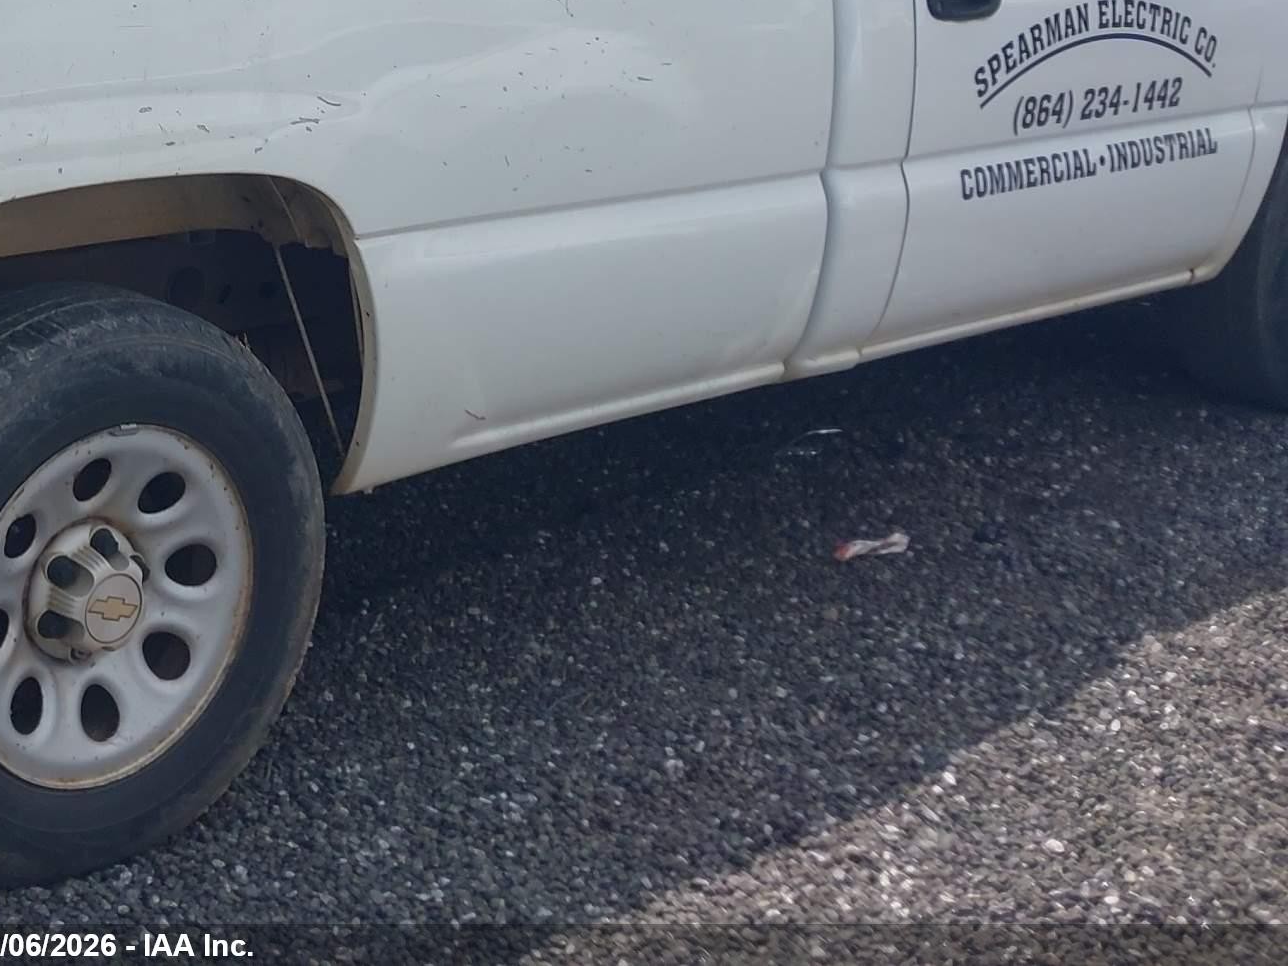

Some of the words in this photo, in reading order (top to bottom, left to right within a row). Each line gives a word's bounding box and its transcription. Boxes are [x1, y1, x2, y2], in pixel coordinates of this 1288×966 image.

[974, 2, 1090, 98] SPEARMAN
[1013, 89, 1074, 136] (864)
[1080, 77, 1183, 120] 234-1442
